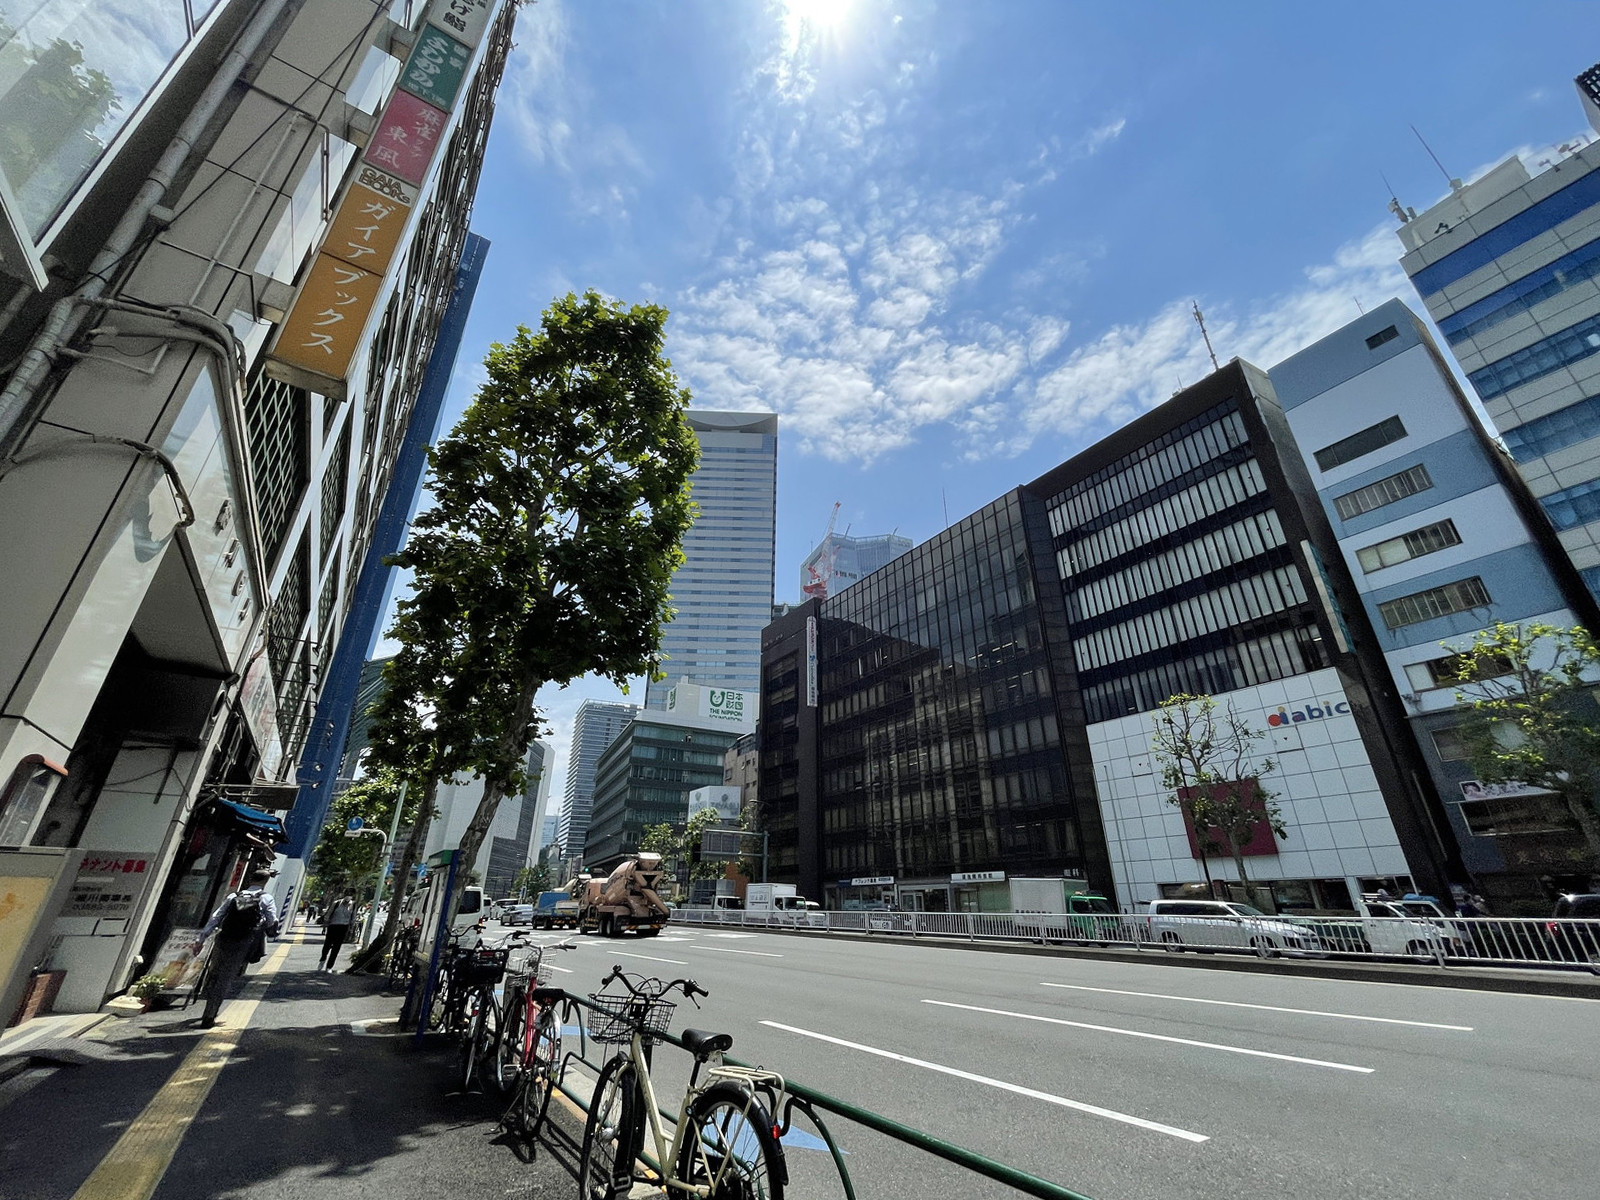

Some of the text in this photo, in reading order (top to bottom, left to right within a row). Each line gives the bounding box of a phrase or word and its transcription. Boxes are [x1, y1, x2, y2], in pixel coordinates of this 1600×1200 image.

[373, 125, 409, 169] 東風
[359, 173, 411, 204] BOOKS
[362, 167, 403, 191] GAIA
[301, 202, 397, 355] ガイアブックス
[726, 691, 744, 701] 日本
[709, 707, 743, 718] THE NIPPON
